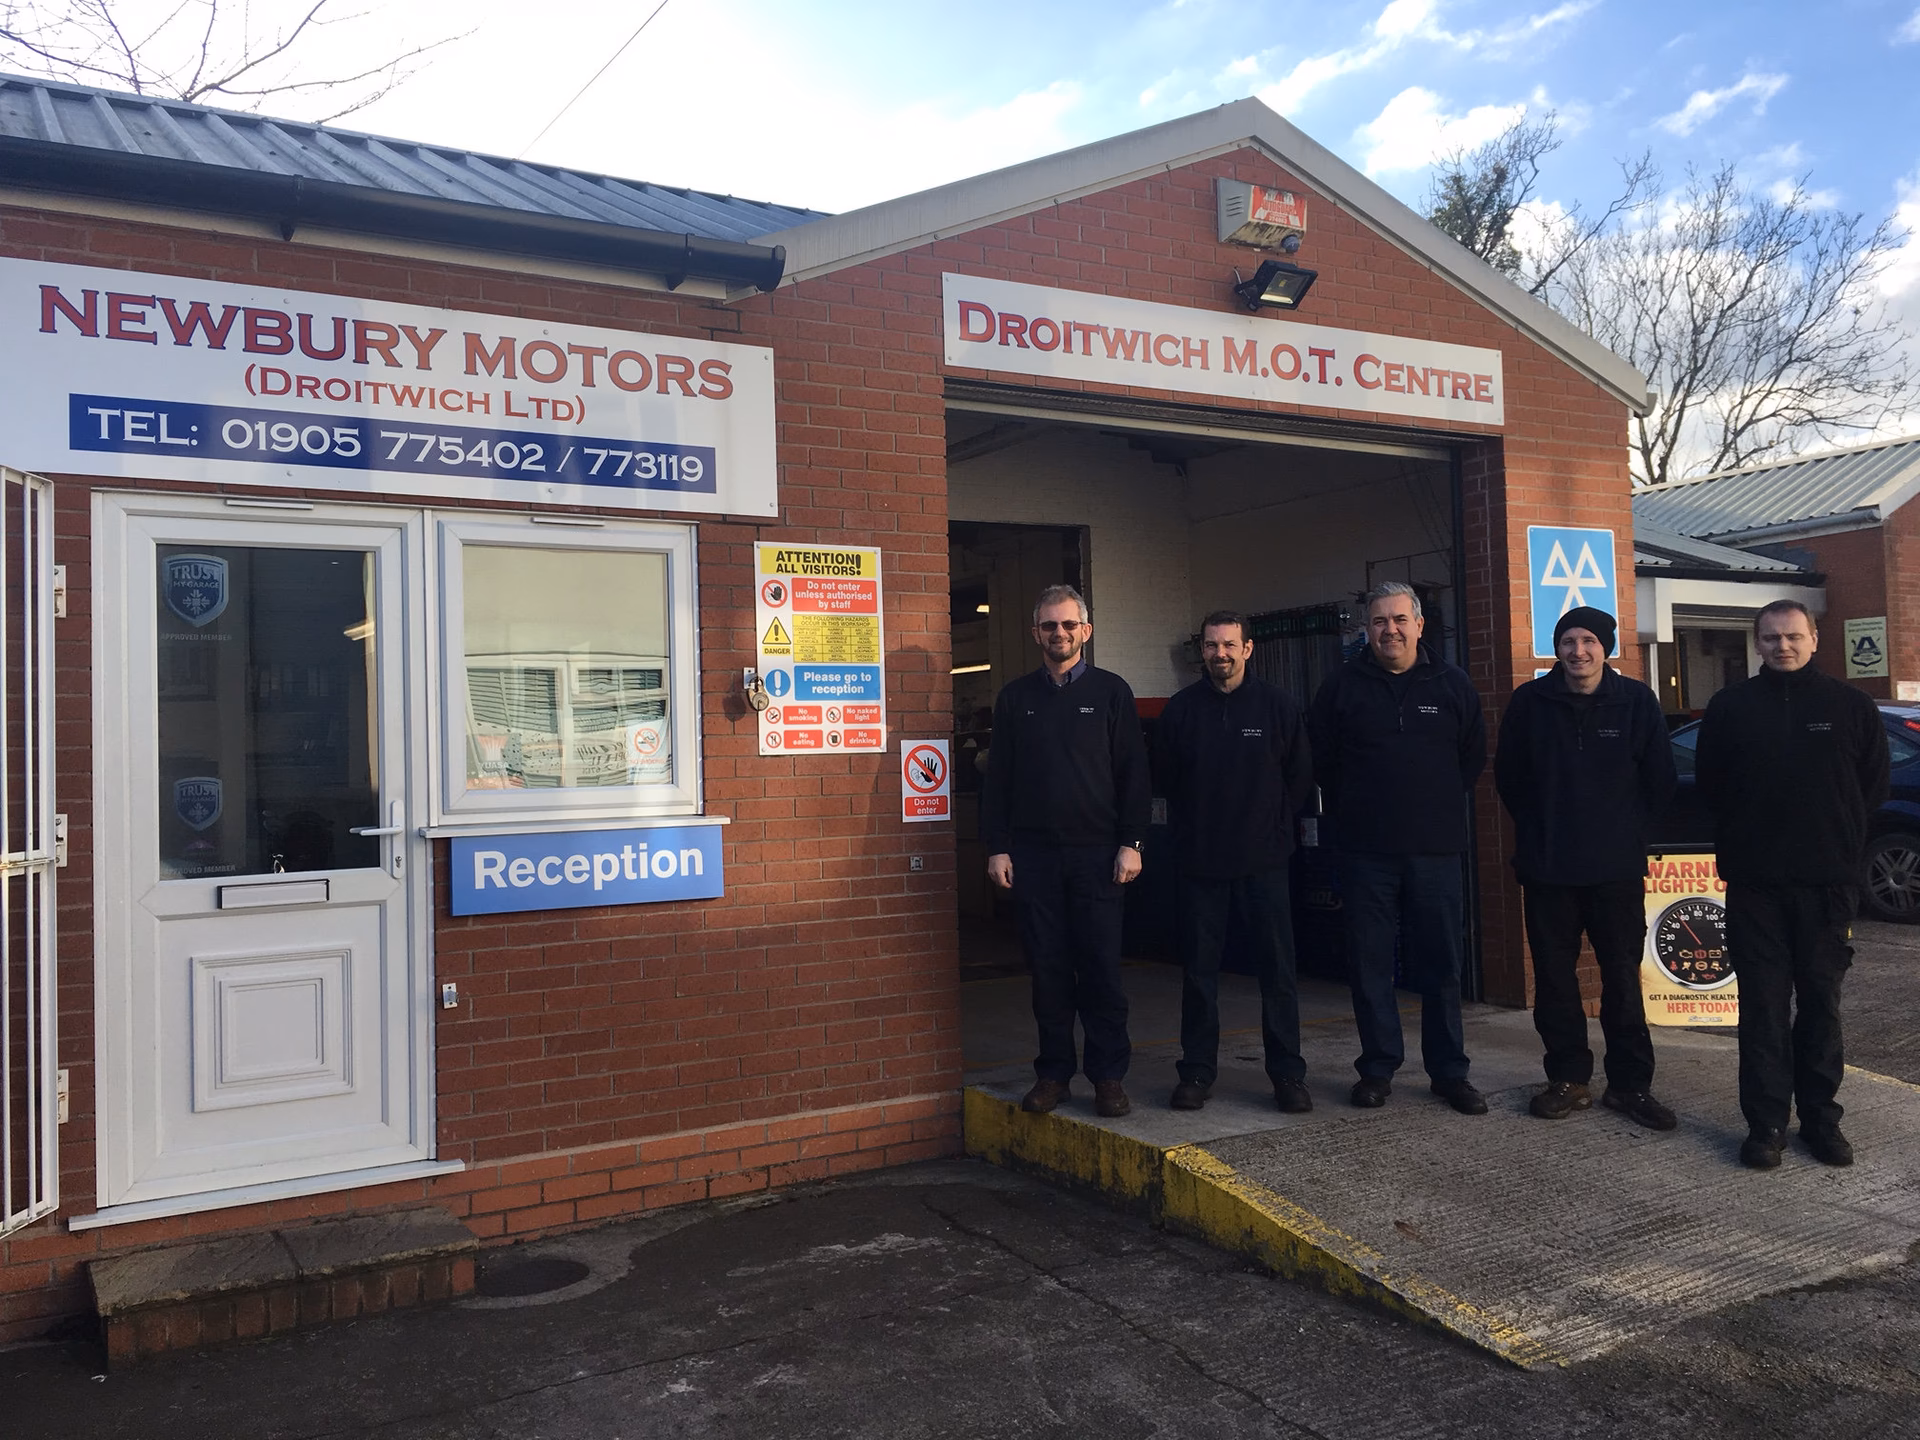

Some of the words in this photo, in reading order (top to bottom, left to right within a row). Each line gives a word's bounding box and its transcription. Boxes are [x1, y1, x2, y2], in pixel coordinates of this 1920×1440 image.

[39, 284, 447, 371] NEWBURY
[463, 332, 733, 400] MOTORS
[958, 300, 1210, 370] DROITWICH
[1222, 336, 1343, 387] M.O.T.
[1353, 353, 1494, 404] CENTRE
[87, 406, 198, 446] TEL:
[222, 418, 361, 457] 01905
[380, 430, 546, 472] 775402
[583, 447, 704, 482] 773119
[776, 563, 798, 574] ALL
[807, 581, 820, 589] Do
[821, 581, 835, 590] not
[838, 583, 861, 591] enter
[795, 590, 824, 599] unless
[826, 590, 873, 600] authorised
[818, 600, 828, 610] by
[831, 600, 851, 609] staff
[803, 671, 841, 682] Please
[844, 674, 858, 683] go
[859, 672, 872, 682] to
[812, 684, 865, 696] reception
[854, 714, 870, 722] light
[914, 798, 925, 806] Do
[926, 797, 939, 805] not
[474, 842, 704, 891] Reception
[1647, 861, 1718, 879] WARNI
[1644, 879, 1708, 894] LIGHTS
[1713, 878, 1728, 893] O
[1667, 1002, 1697, 1013] HERE
[1698, 1002, 1738, 1013] TODAY
